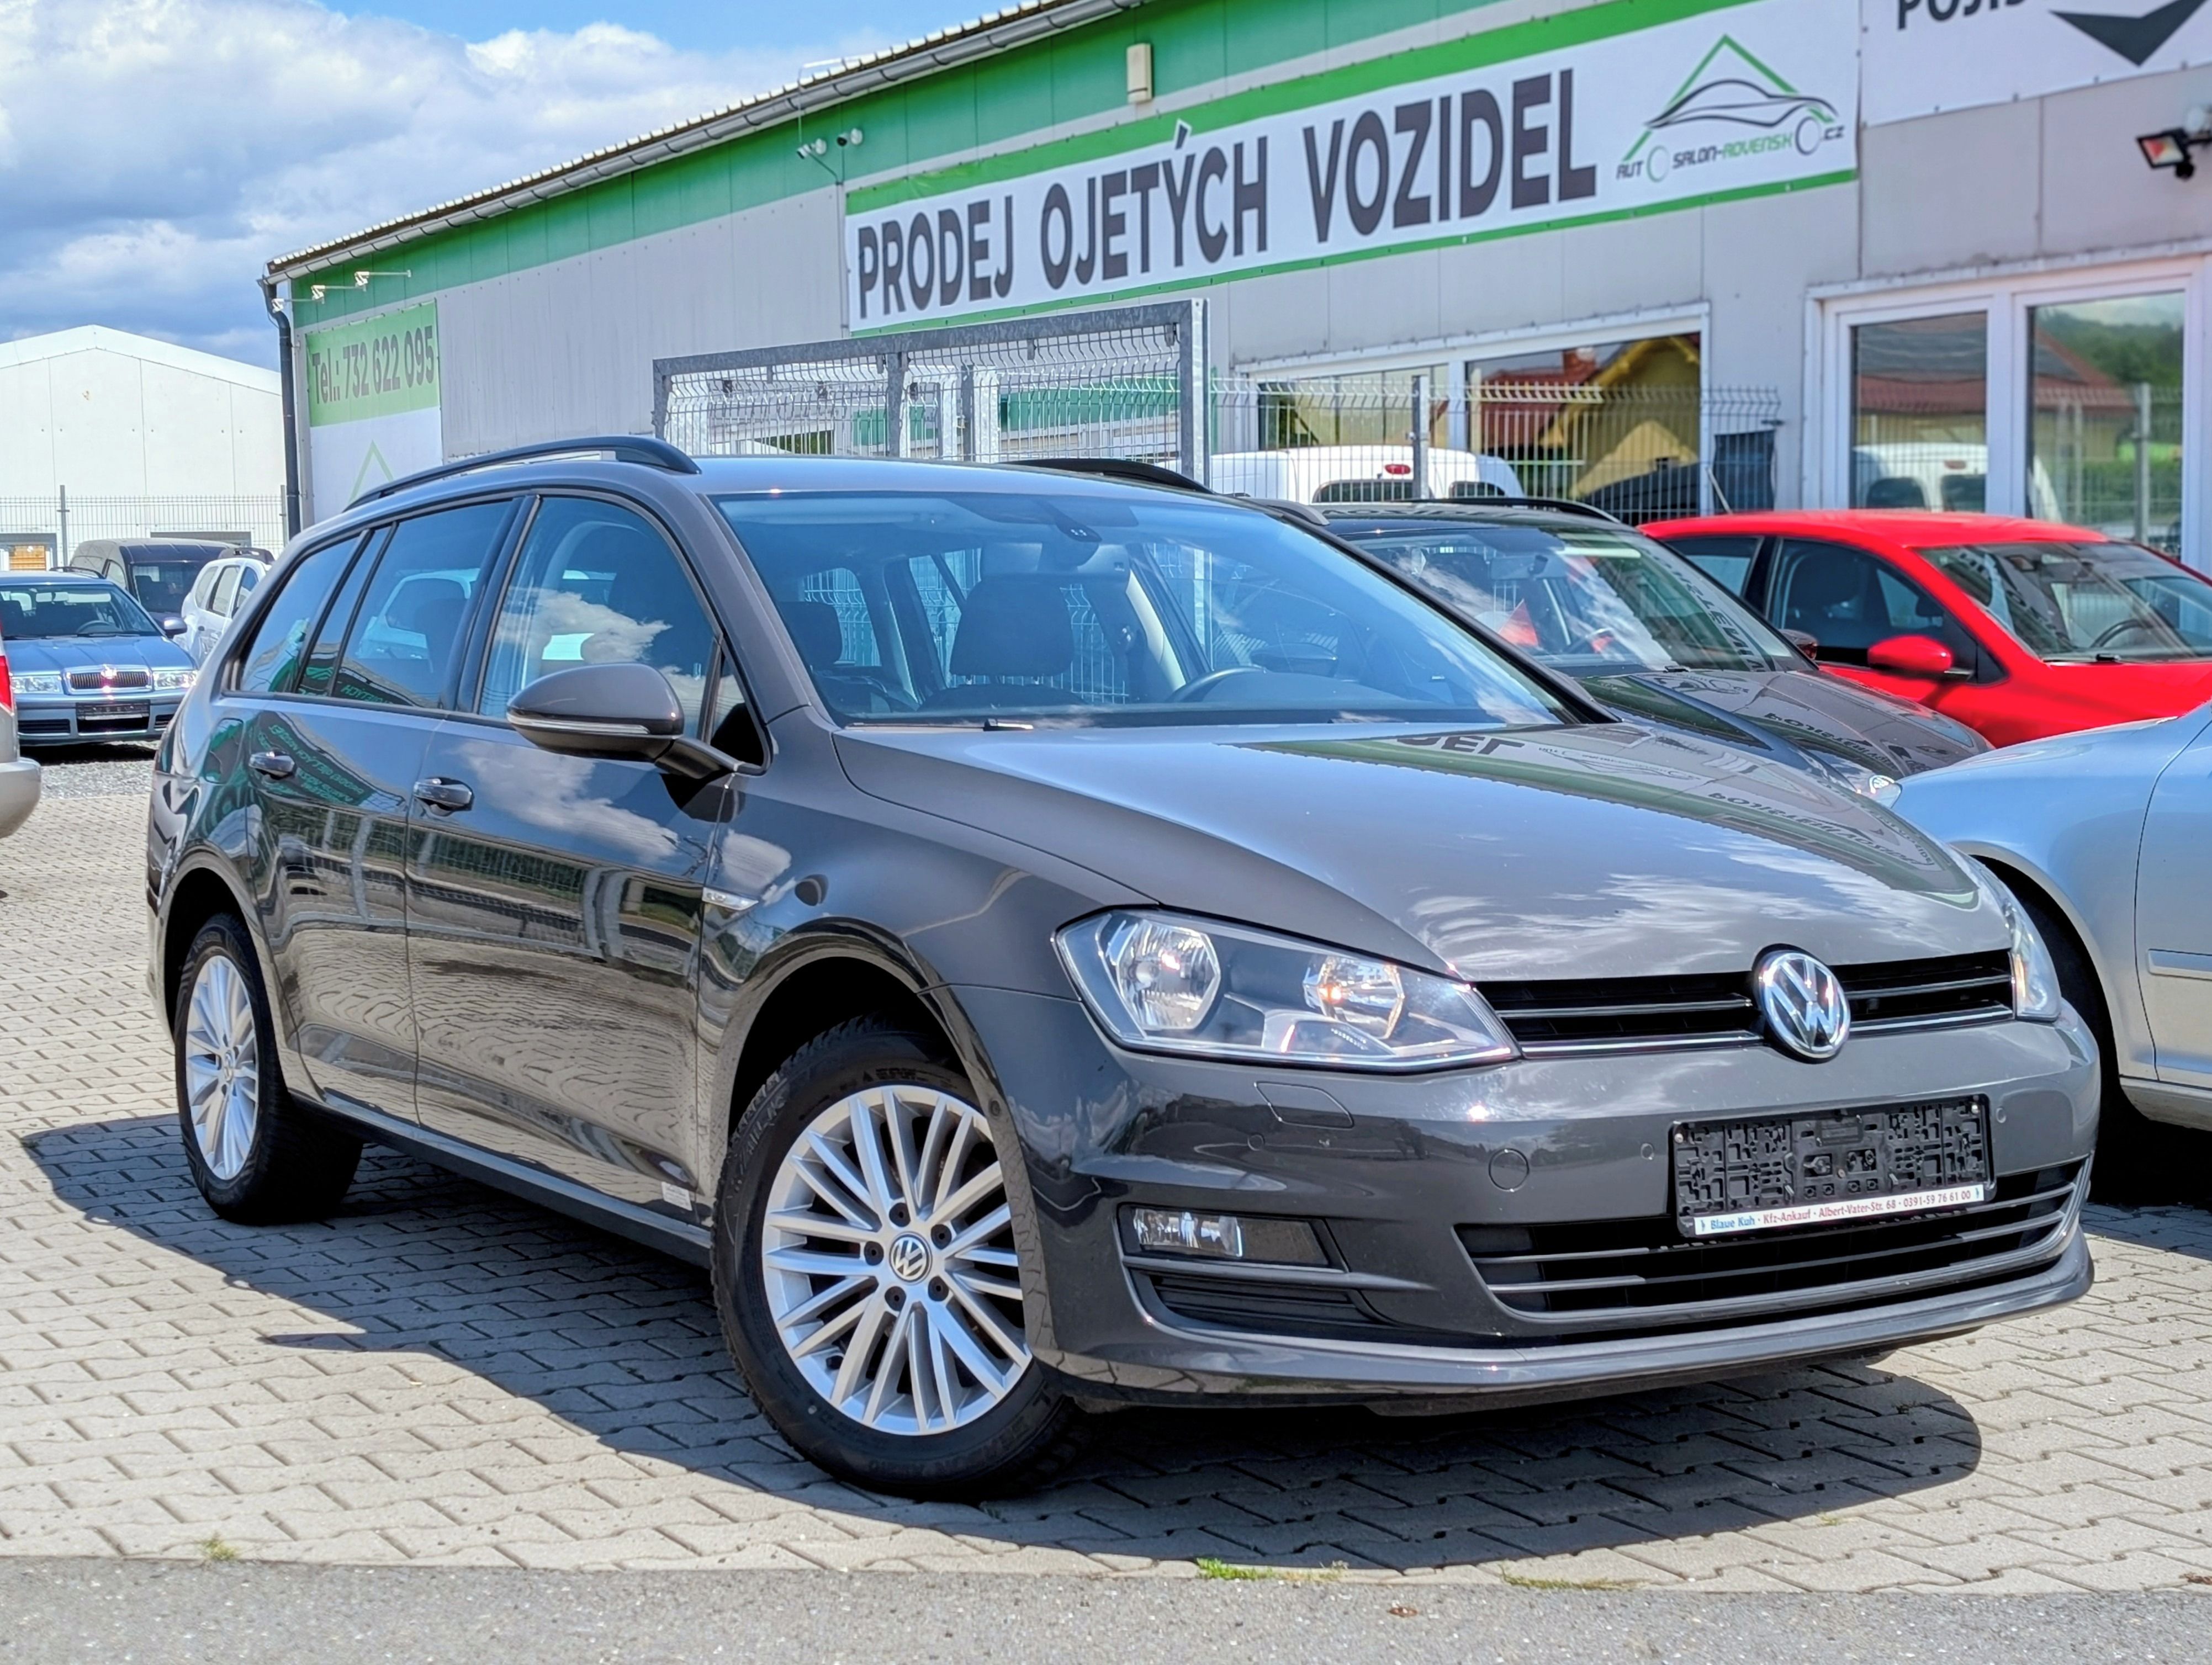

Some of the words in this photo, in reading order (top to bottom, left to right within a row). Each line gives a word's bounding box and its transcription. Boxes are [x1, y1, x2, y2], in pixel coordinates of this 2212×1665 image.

[858, 194, 1014, 320] PRODEJ
[1040, 121, 1268, 290] OJETÝCH
[1302, 68, 1597, 243] VOZIDEL
[312, 348, 341, 404] Tel.:
[342, 342, 369, 399] 732
[372, 334, 401, 394] 622
[404, 325, 435, 389] 095
[1711, 1219, 1735, 1230] Blaue
[1738, 1216, 1755, 1227] Kuh
[1763, 1209, 1811, 1224] Kfz-Ankauf
[1886, 1200, 1897, 1210] 68
[1904, 1195, 1936, 1207] 0391-59
[1938, 1193, 1948, 1203] 76
[1949, 1191, 1959, 1202] 61
[1961, 1190, 1971, 1200] 00
